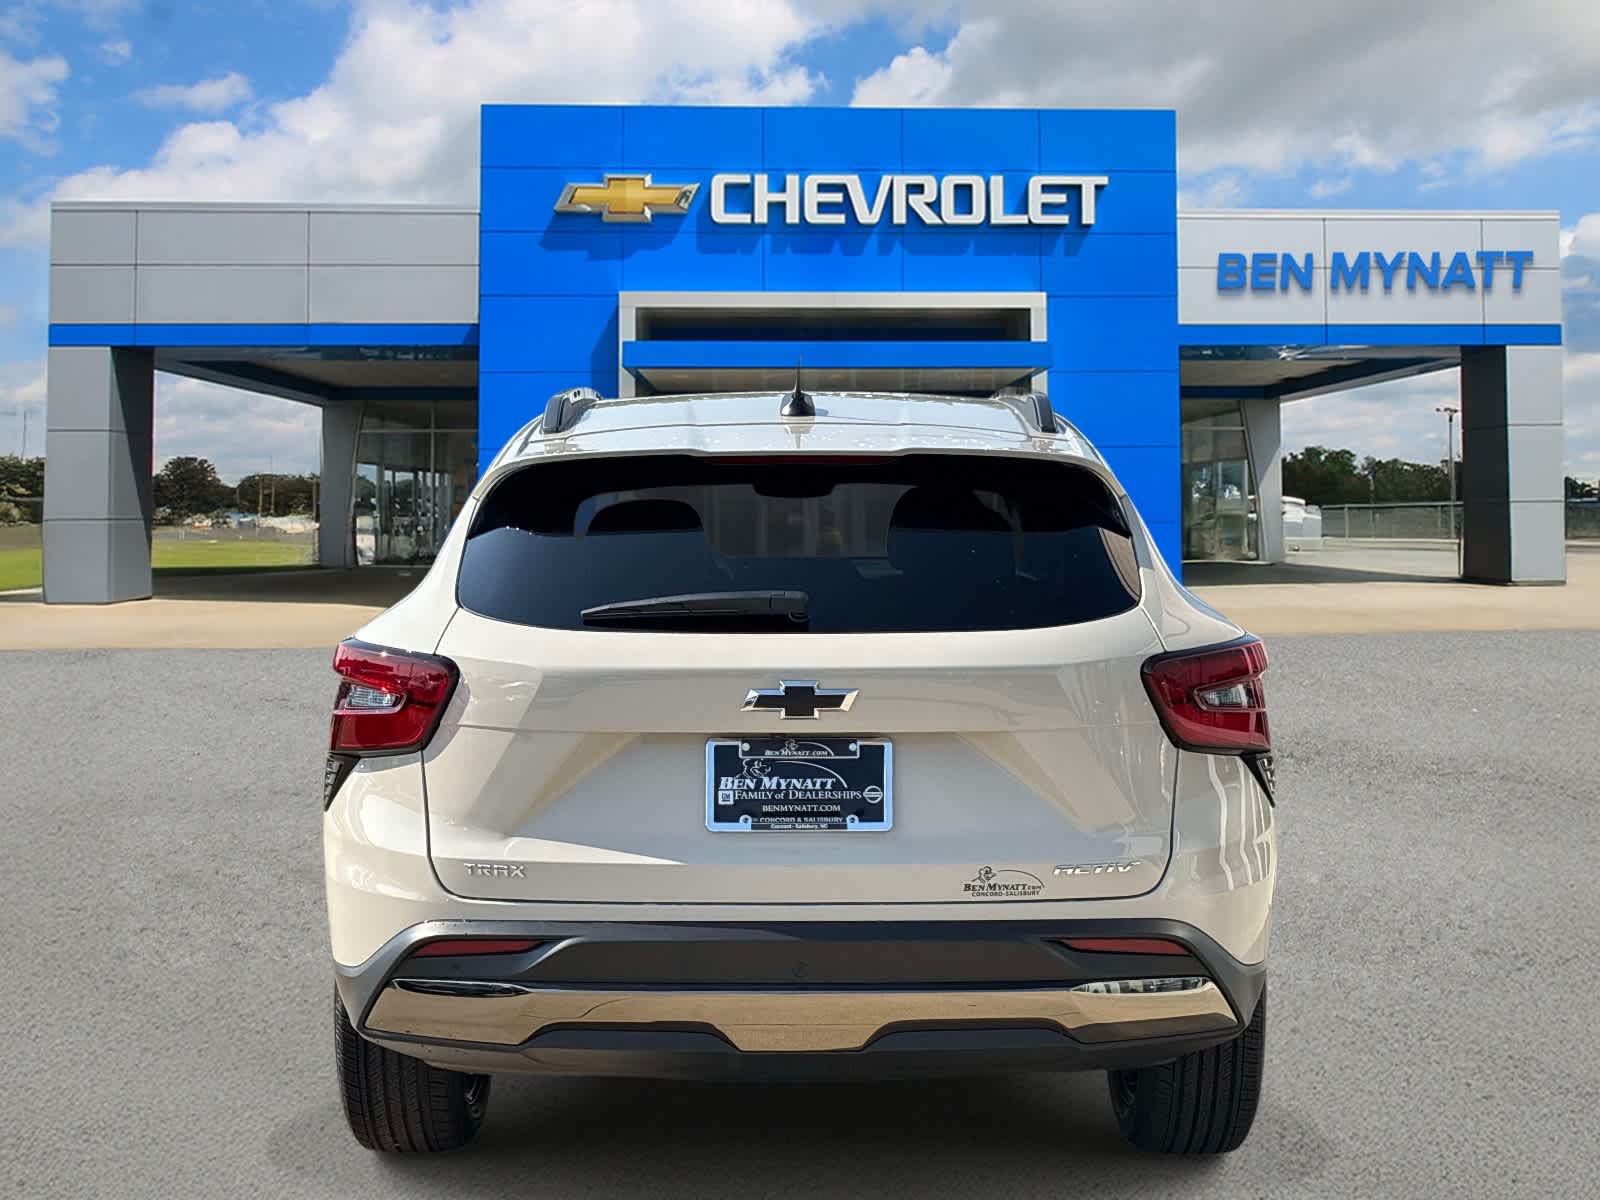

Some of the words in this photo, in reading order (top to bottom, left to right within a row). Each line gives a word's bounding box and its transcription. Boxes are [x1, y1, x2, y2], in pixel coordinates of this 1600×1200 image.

[710, 173, 1109, 225] CHEVROLET
[1217, 252, 1313, 290] BEN
[1330, 250, 1534, 290] MYNATT
[719, 776, 756, 790] BEN
[761, 776, 836, 790] MYNATT
[734, 790, 773, 800] FAMILY
[774, 792, 785, 800] of
[788, 790, 862, 800] DEALERSHIPS
[762, 804, 841, 812] BENMYNATT.COM
[463, 862, 525, 878] TRAX
[1053, 862, 1140, 875] ACTIV
[963, 883, 985, 892] BEN
